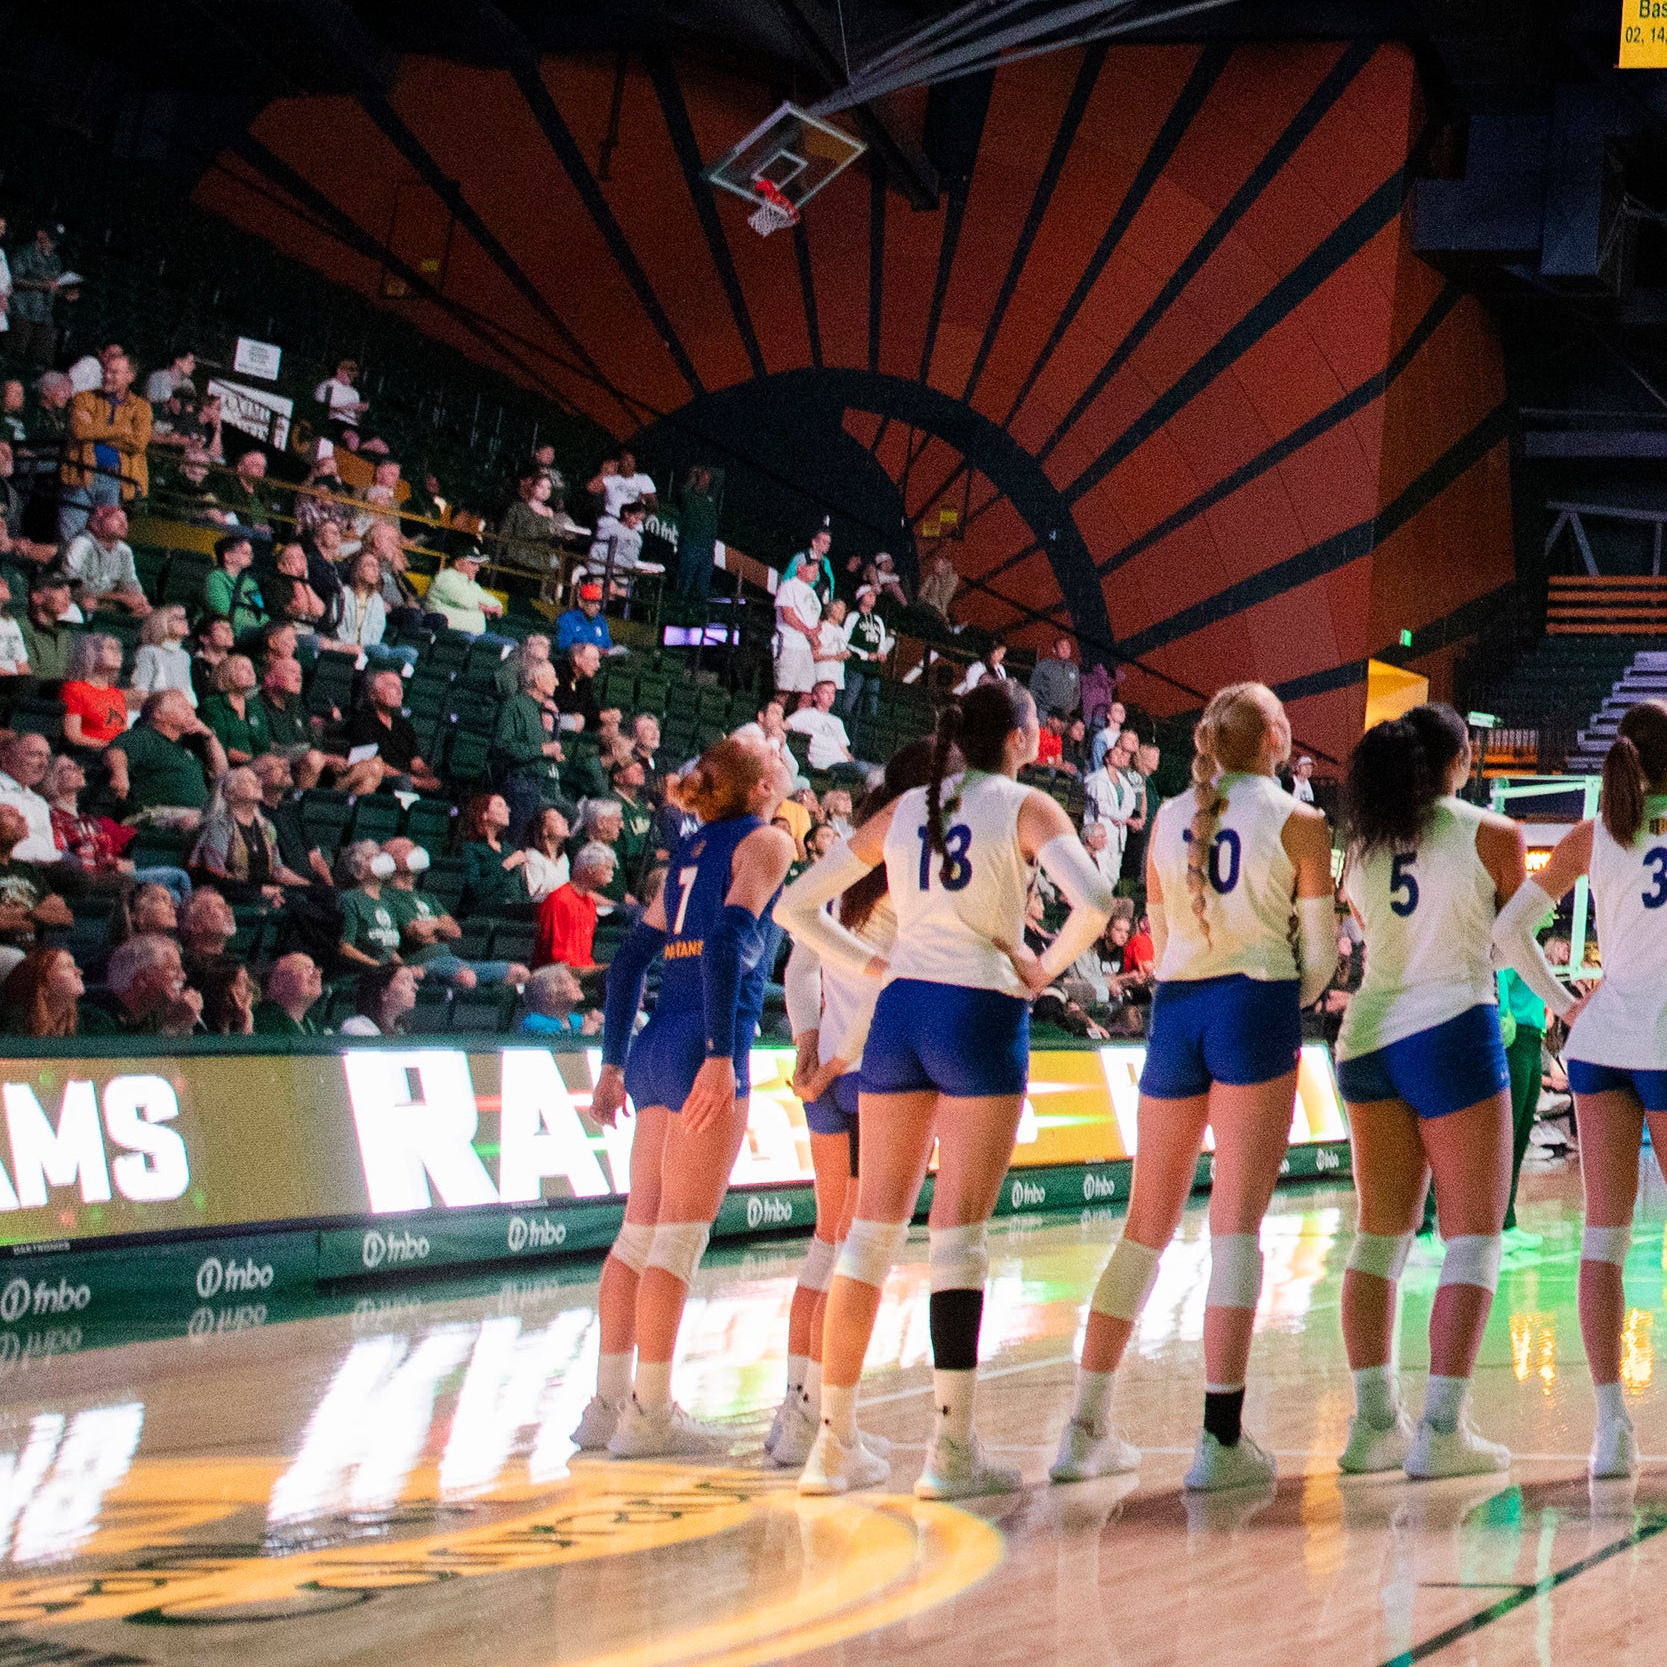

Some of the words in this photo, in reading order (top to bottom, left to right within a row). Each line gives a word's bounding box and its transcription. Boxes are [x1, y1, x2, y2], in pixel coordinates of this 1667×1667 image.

[1625, 26, 1645, 44] 02,
[1390, 852, 1420, 918] 5
[763, 1197, 792, 1223] fnbo
[387, 1232, 430, 1263] fnbo
[529, 1218, 566, 1247] fnbo
[225, 1257, 274, 1292] fnbo
[33, 1279, 91, 1315] fnbo
